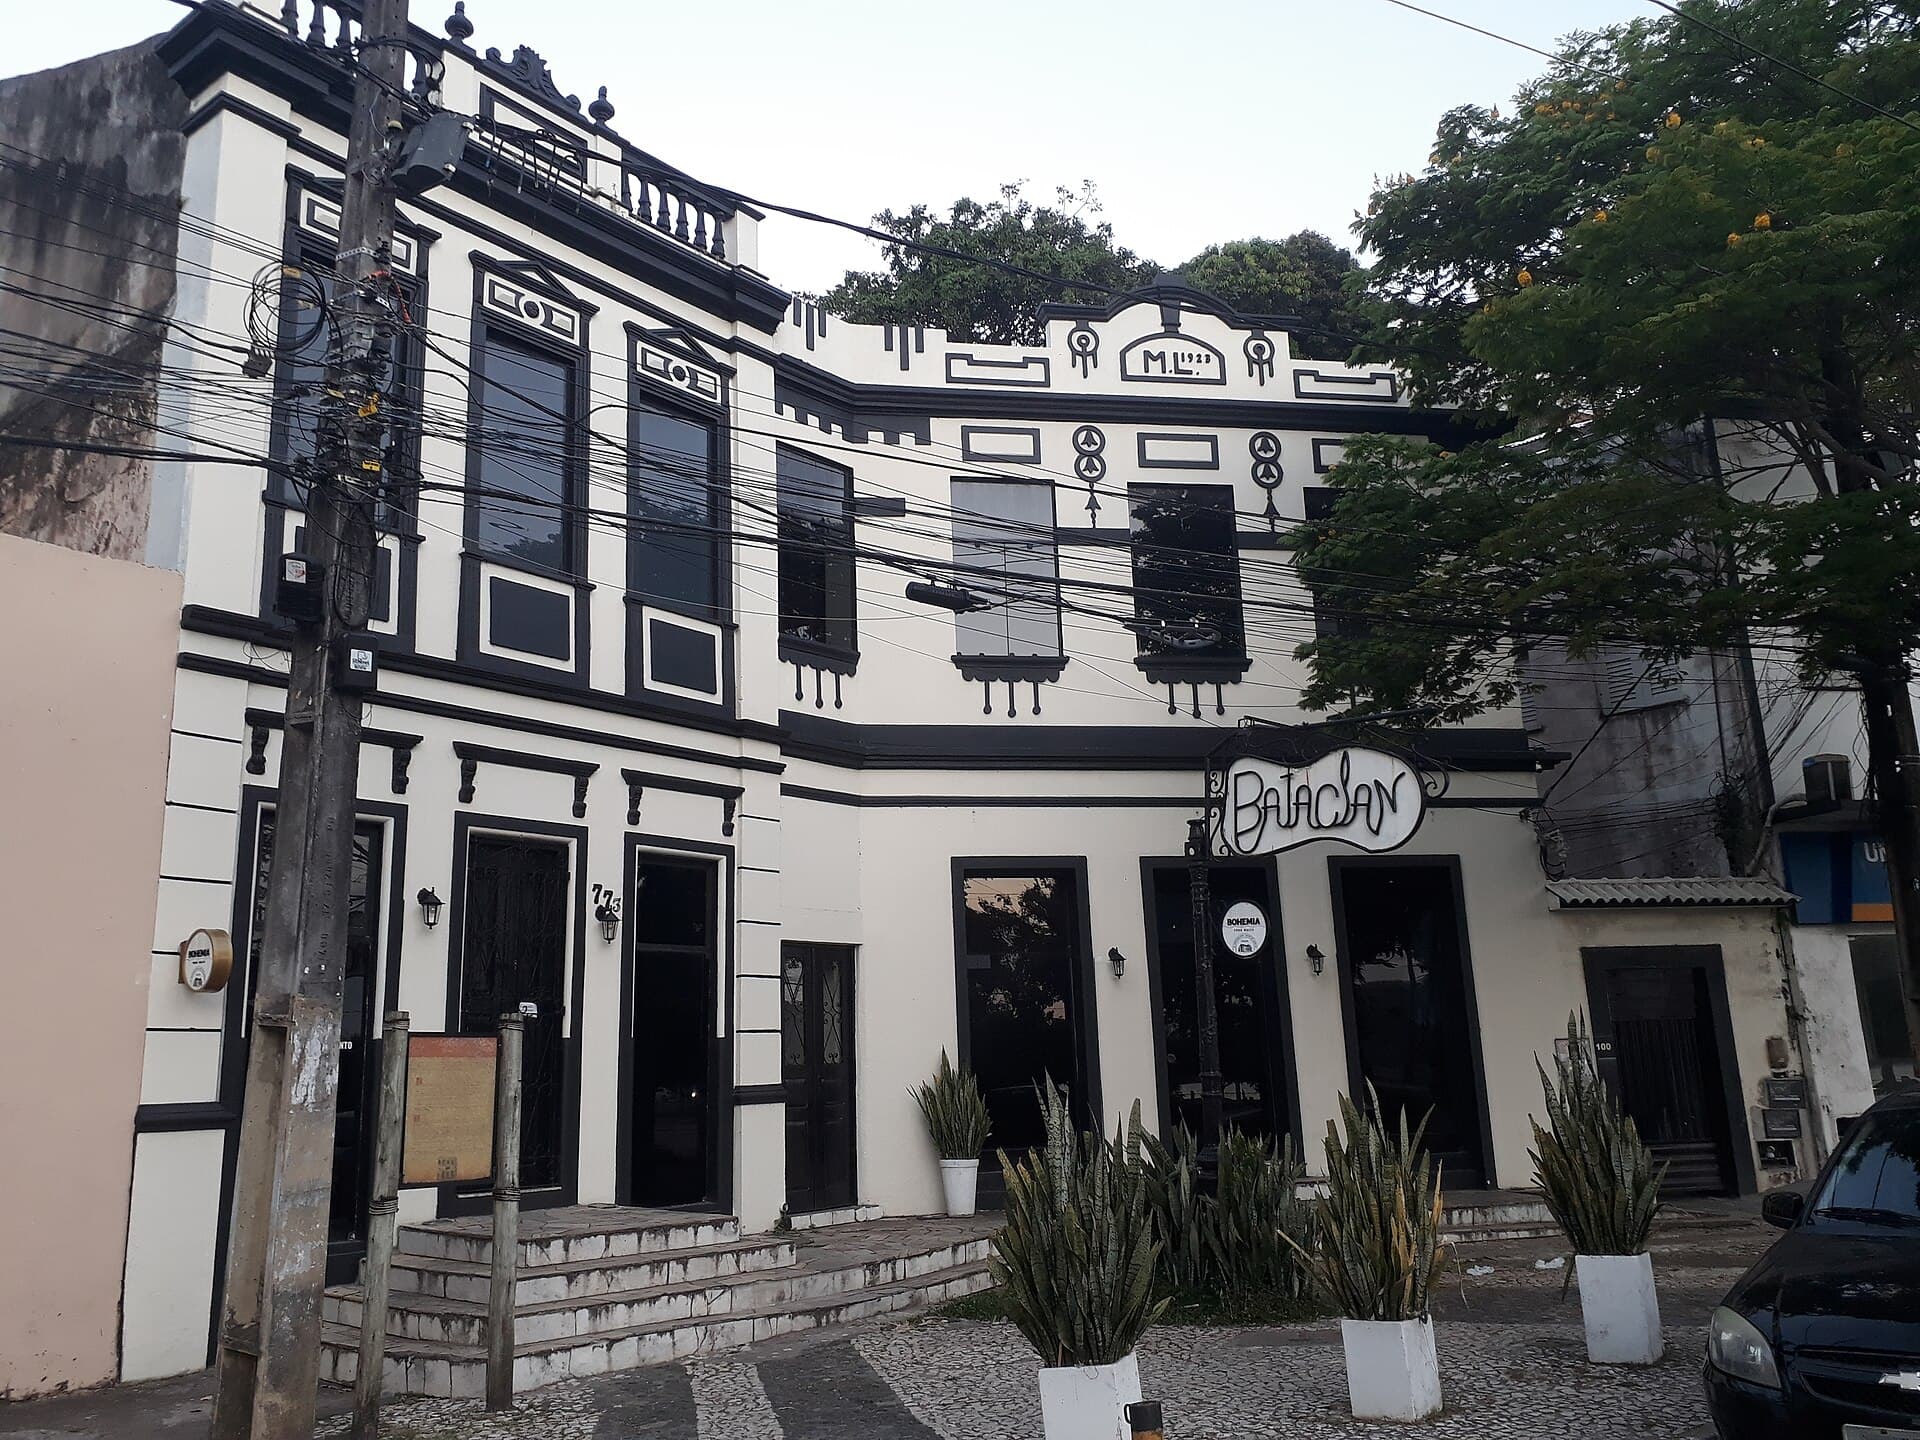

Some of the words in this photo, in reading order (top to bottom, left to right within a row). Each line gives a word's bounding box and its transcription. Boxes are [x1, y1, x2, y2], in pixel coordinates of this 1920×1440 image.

[591, 883, 622, 912] 773
[1226, 917, 1261, 926] BOHEMIA
[1596, 1042, 1612, 1051] 100
